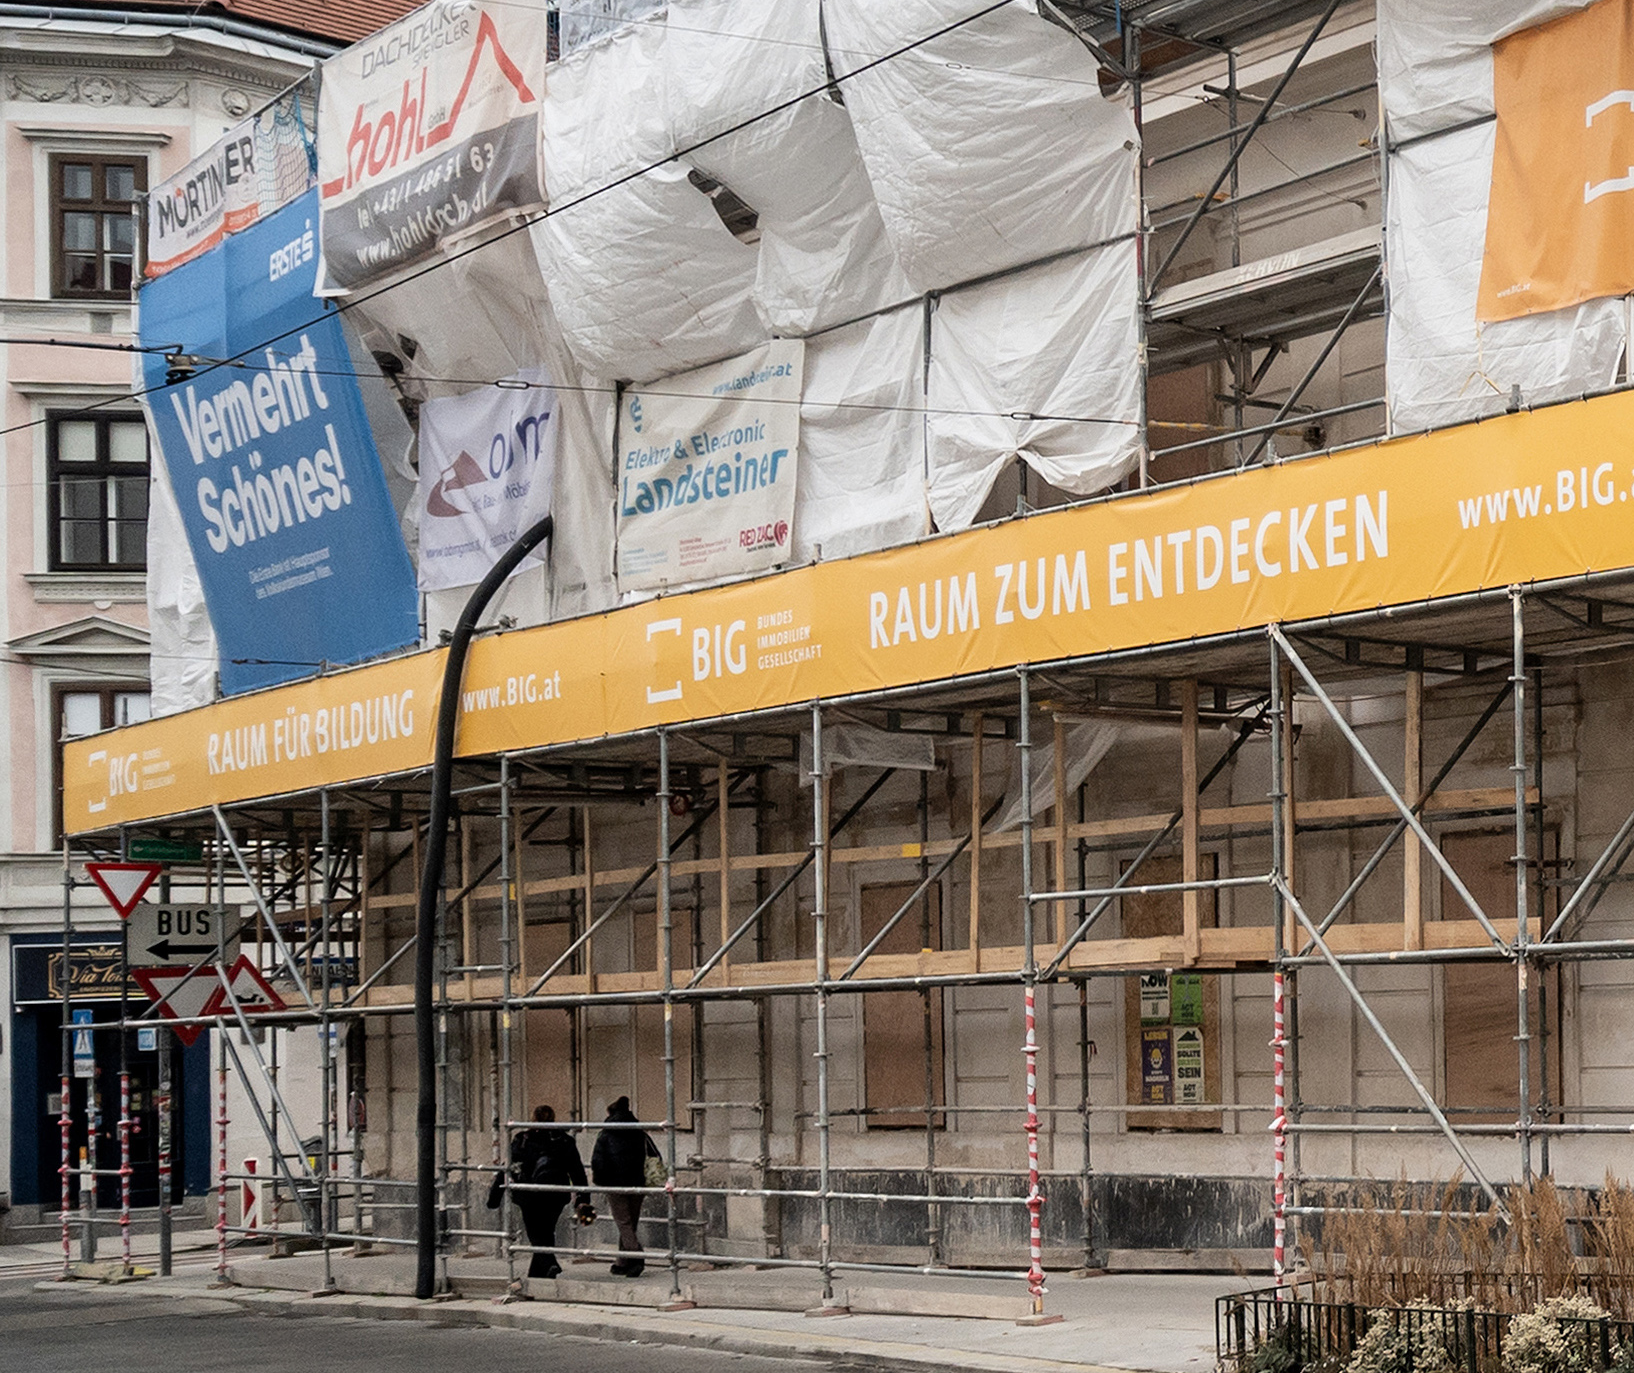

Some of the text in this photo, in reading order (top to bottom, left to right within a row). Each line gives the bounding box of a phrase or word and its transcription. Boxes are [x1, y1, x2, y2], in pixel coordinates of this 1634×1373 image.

[346, 67, 427, 190] hohl
[171, 334, 329, 465] Vermehrt
[673, 440, 688, 459] &
[197, 423, 351, 553] Schönes!
[622, 449, 788, 517] Landsteiner
[869, 489, 1390, 650] RAUM ZUM ENTDECKEN
[756, 609, 794, 629] BUNDES
[756, 624, 812, 650] IMMOBILIEN
[691, 618, 747, 682] BIG
[757, 643, 822, 671] GESELLSCHAFT
[463, 669, 562, 713] www.BIG.at
[207, 688, 414, 776] RAUM FÜR BILDUNG
[108, 751, 138, 798] BIG
[157, 910, 210, 936] BUS
[1178, 1067, 1201, 1078] SEIN
